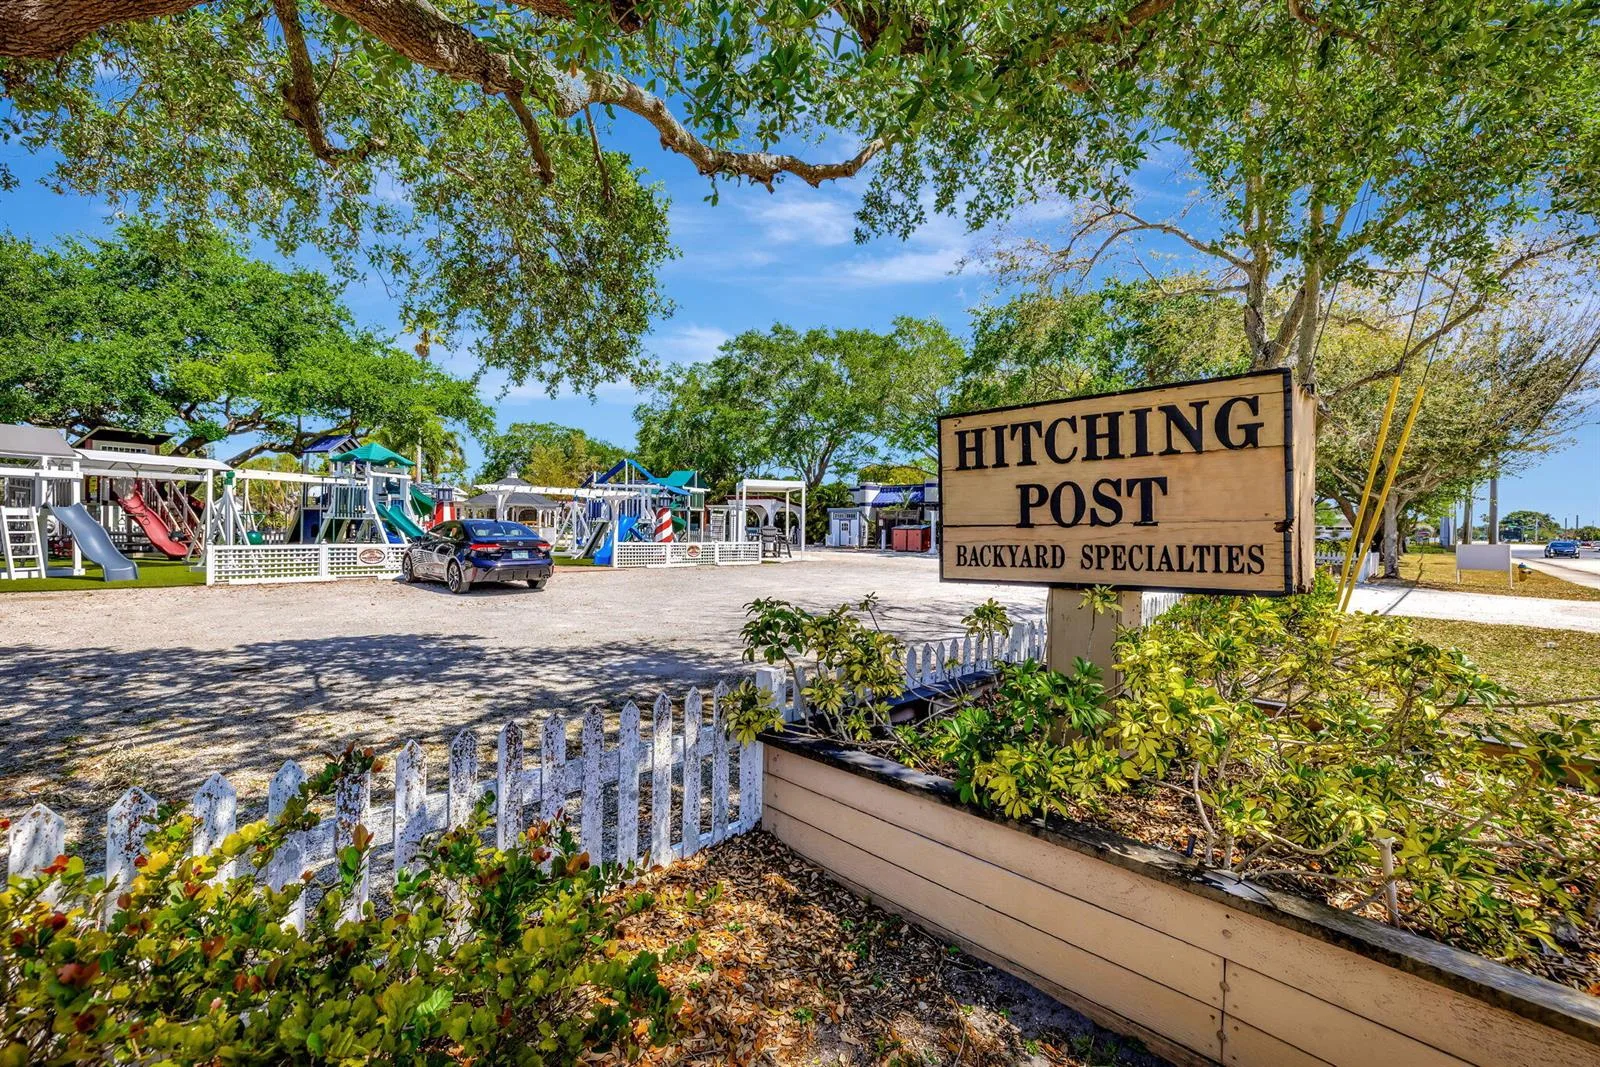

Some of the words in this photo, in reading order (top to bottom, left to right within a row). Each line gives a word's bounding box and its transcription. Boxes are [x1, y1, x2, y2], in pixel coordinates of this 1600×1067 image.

[955, 395, 1264, 471] HITCHING
[1015, 476, 1168, 528] POST
[956, 544, 1066, 569] BACKYARD
[1080, 544, 1265, 575] SPECIALTIES
